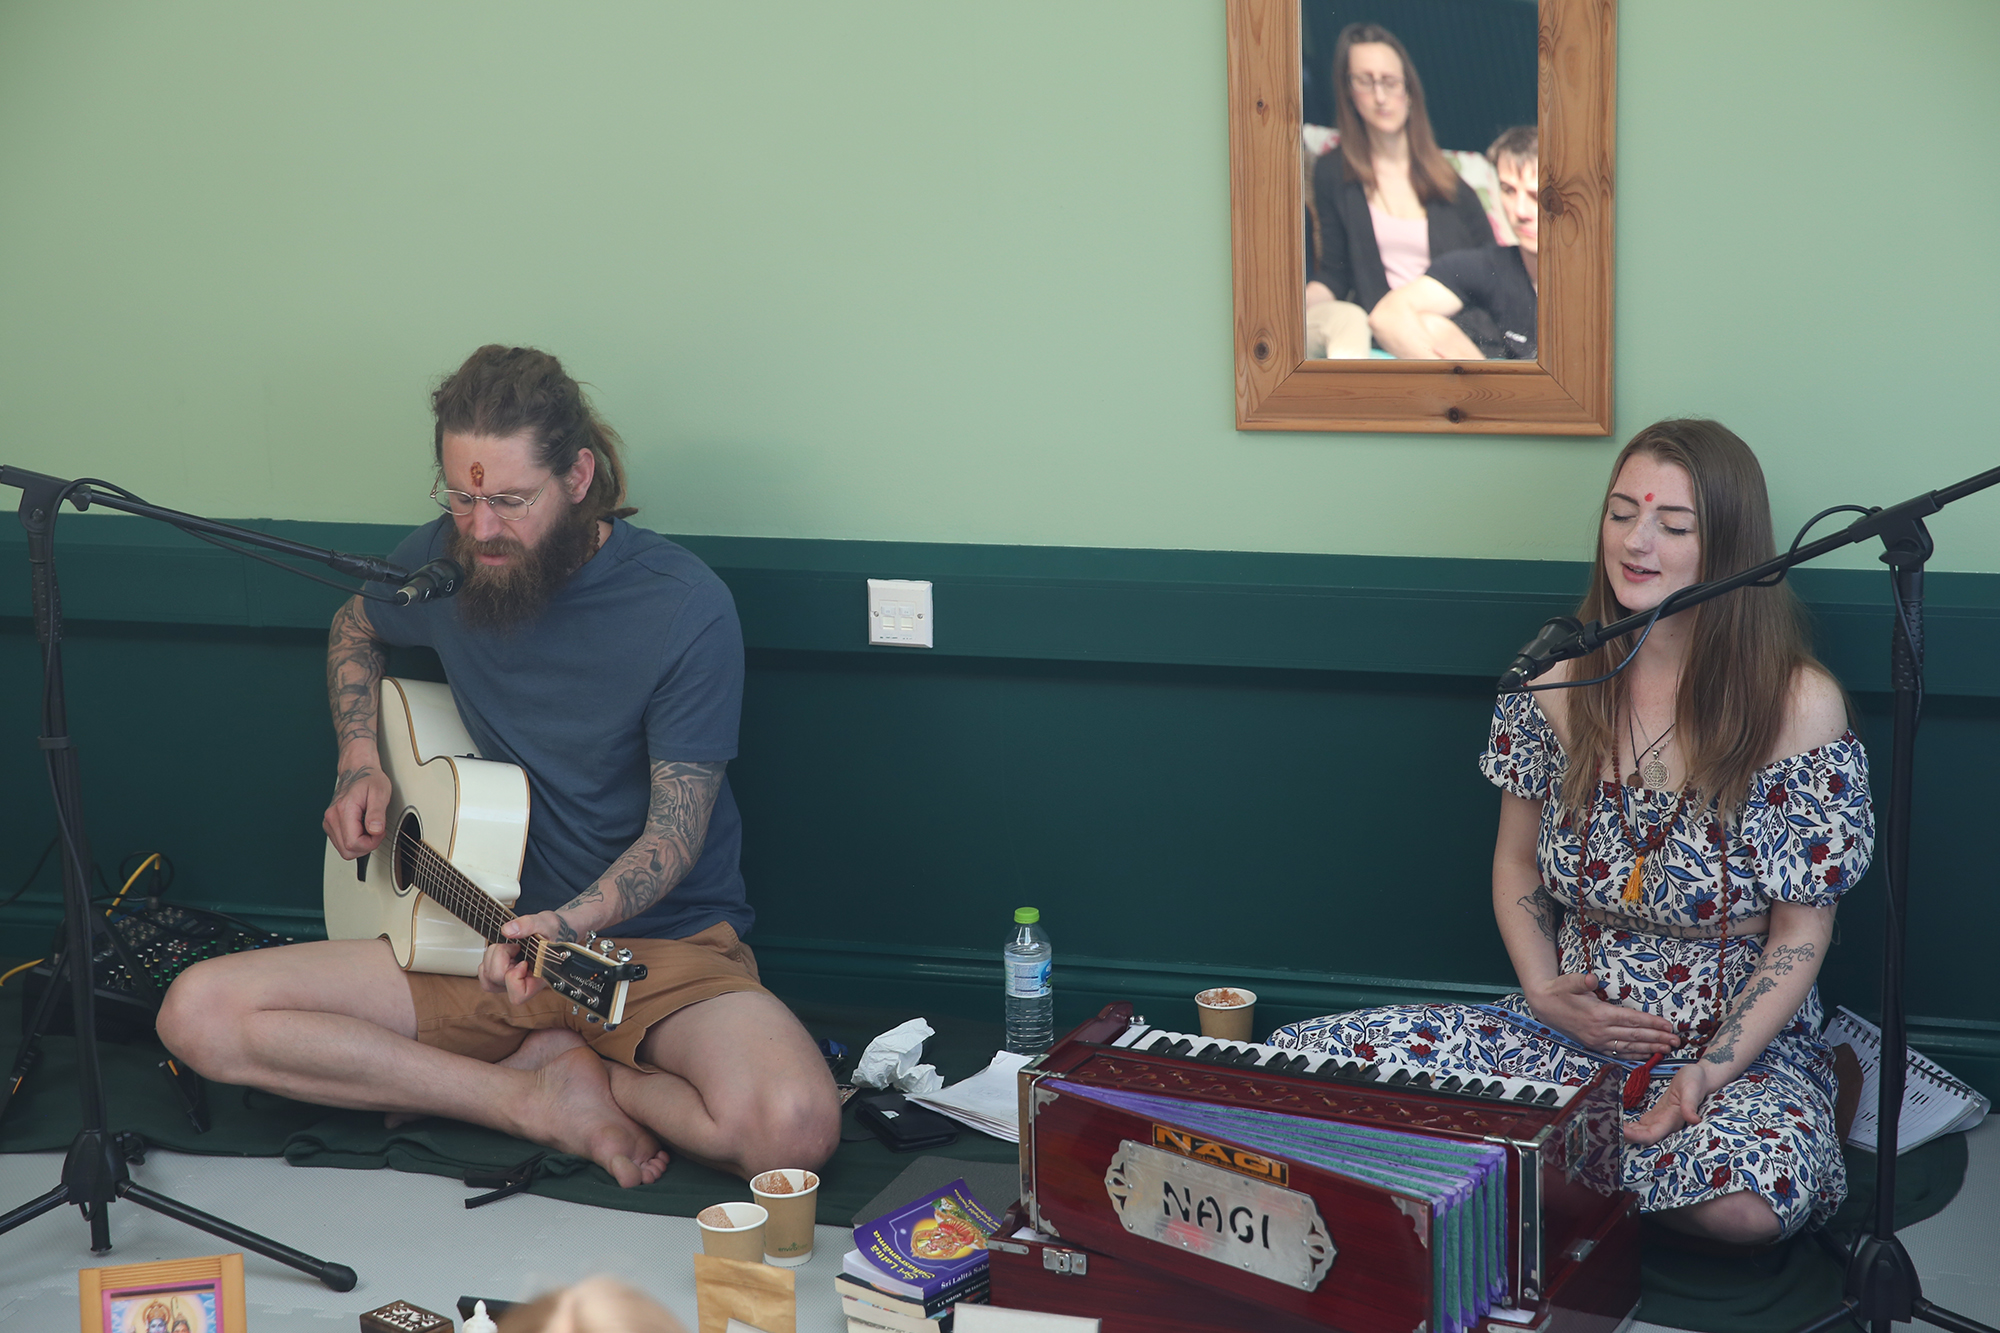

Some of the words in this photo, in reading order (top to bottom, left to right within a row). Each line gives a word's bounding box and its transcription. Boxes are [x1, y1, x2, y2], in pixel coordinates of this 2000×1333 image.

[1772, 943, 1815, 962] Sunshine
[1156, 1126, 1281, 1179] NAGI
[1163, 1181, 1270, 1250] NAGI
